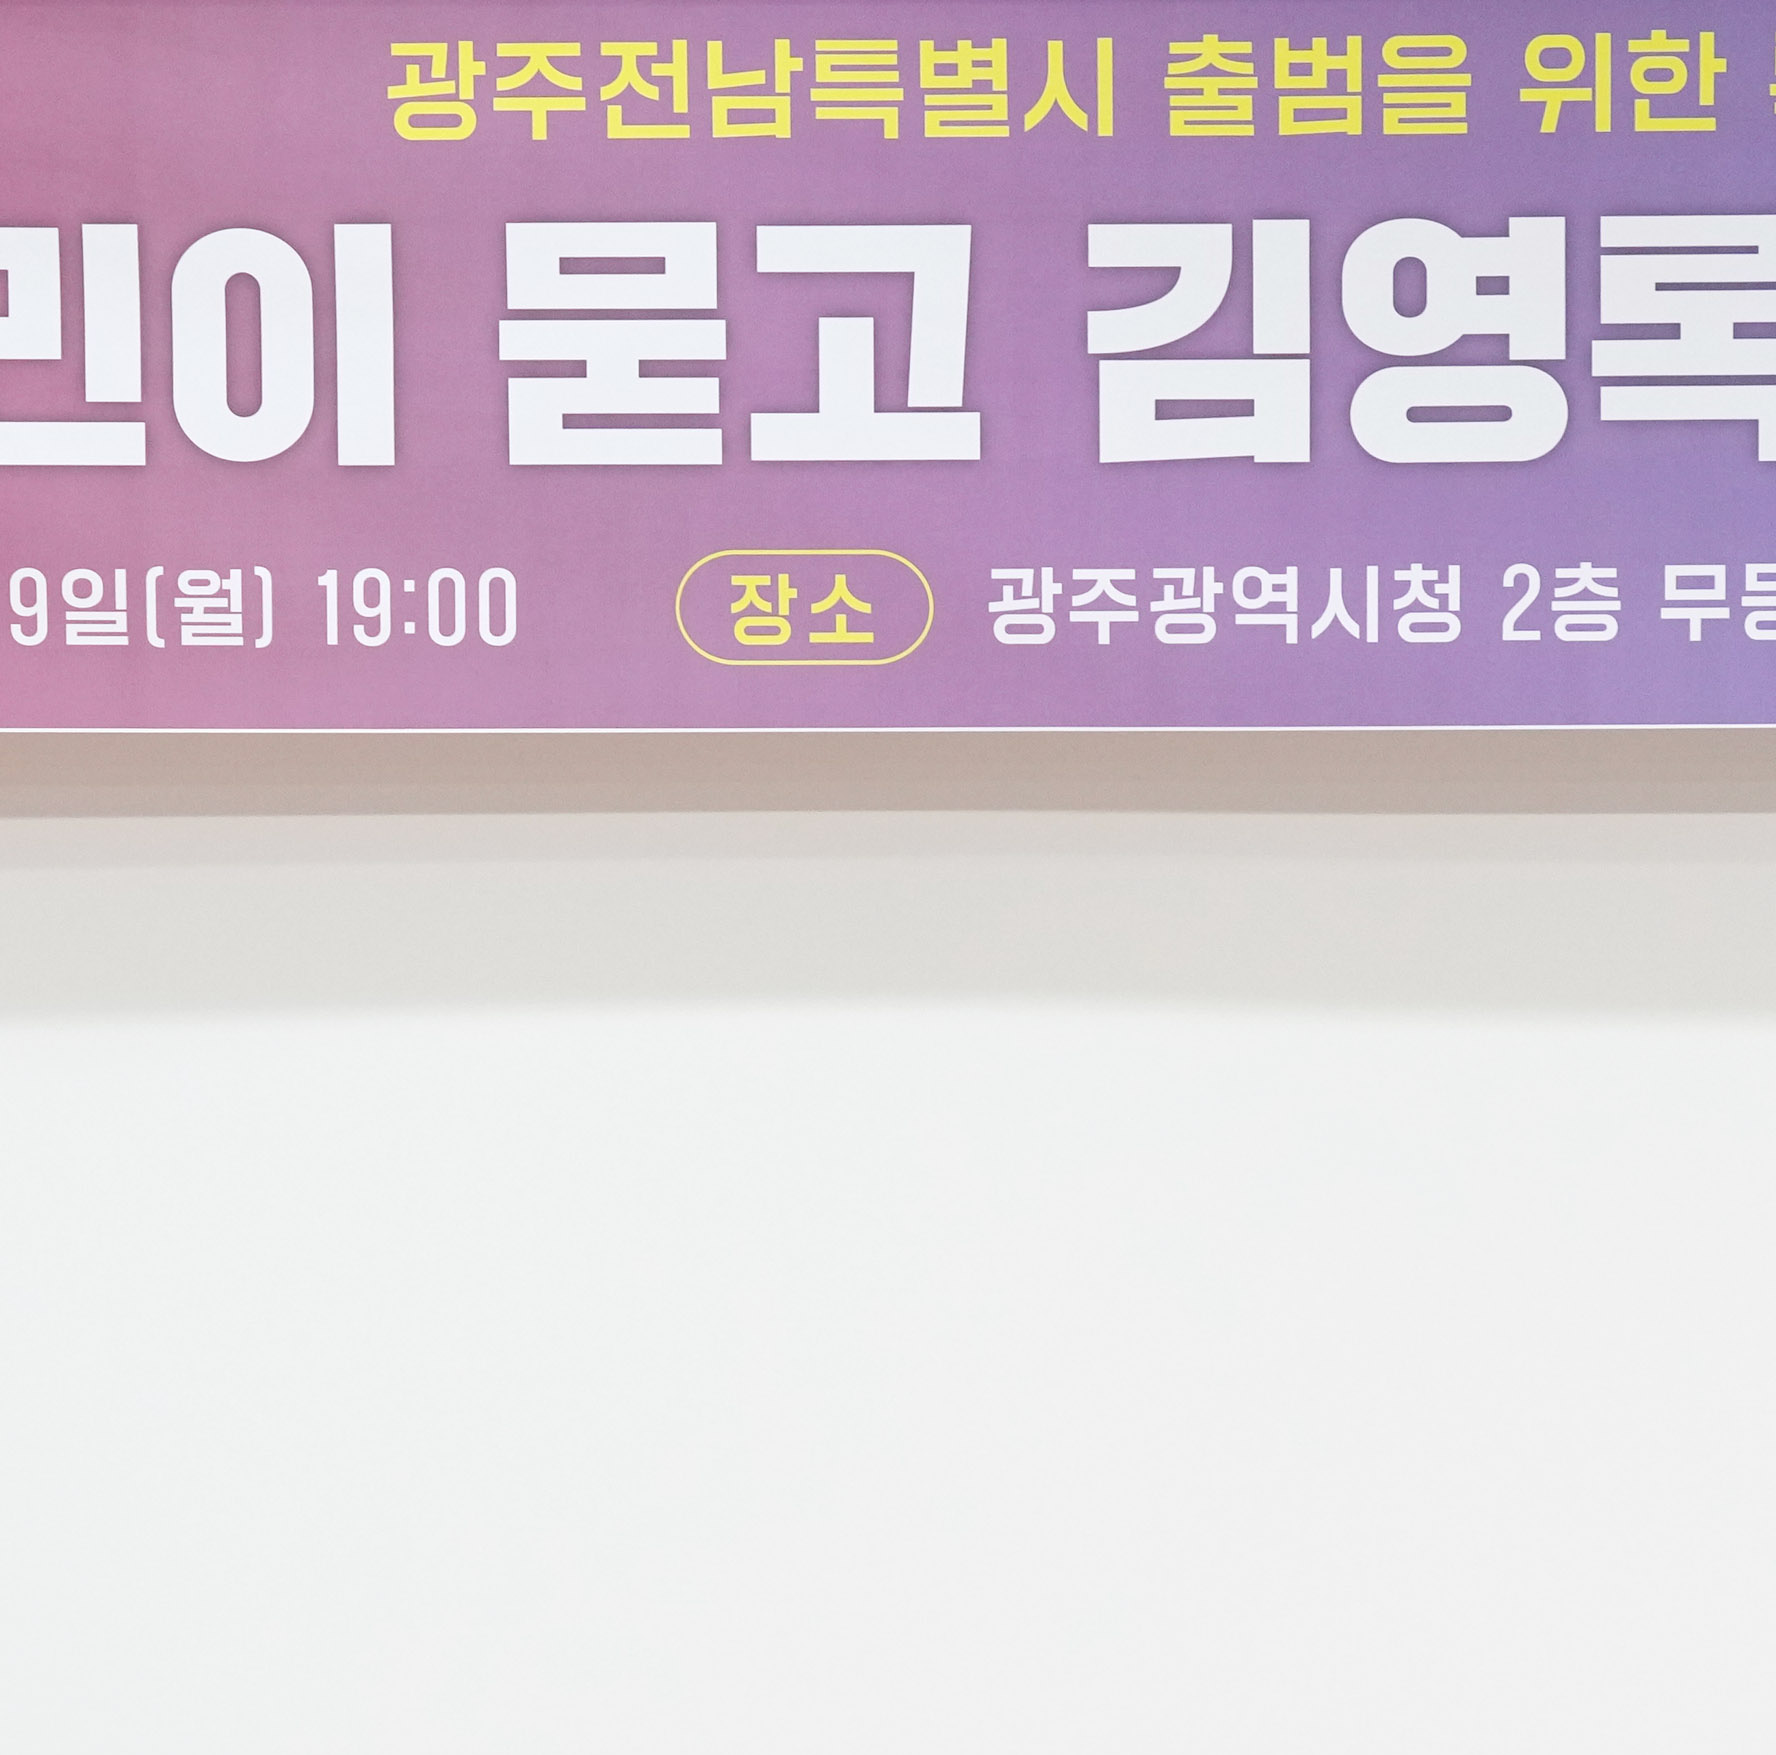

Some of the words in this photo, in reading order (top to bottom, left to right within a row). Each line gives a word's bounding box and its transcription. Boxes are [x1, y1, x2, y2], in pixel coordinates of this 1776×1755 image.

[386, 36, 1115, 142] 광주전남특별시
[1162, 33, 1473, 138] 출범을
[1518, 28, 1728, 134] 위한
[497, 220, 982, 467] 묻고
[316, 566, 518, 648] 19:00
[729, 572, 876, 645] 장소
[987, 562, 1463, 646] 광주광역시청
[1501, 560, 1623, 643] 2층
